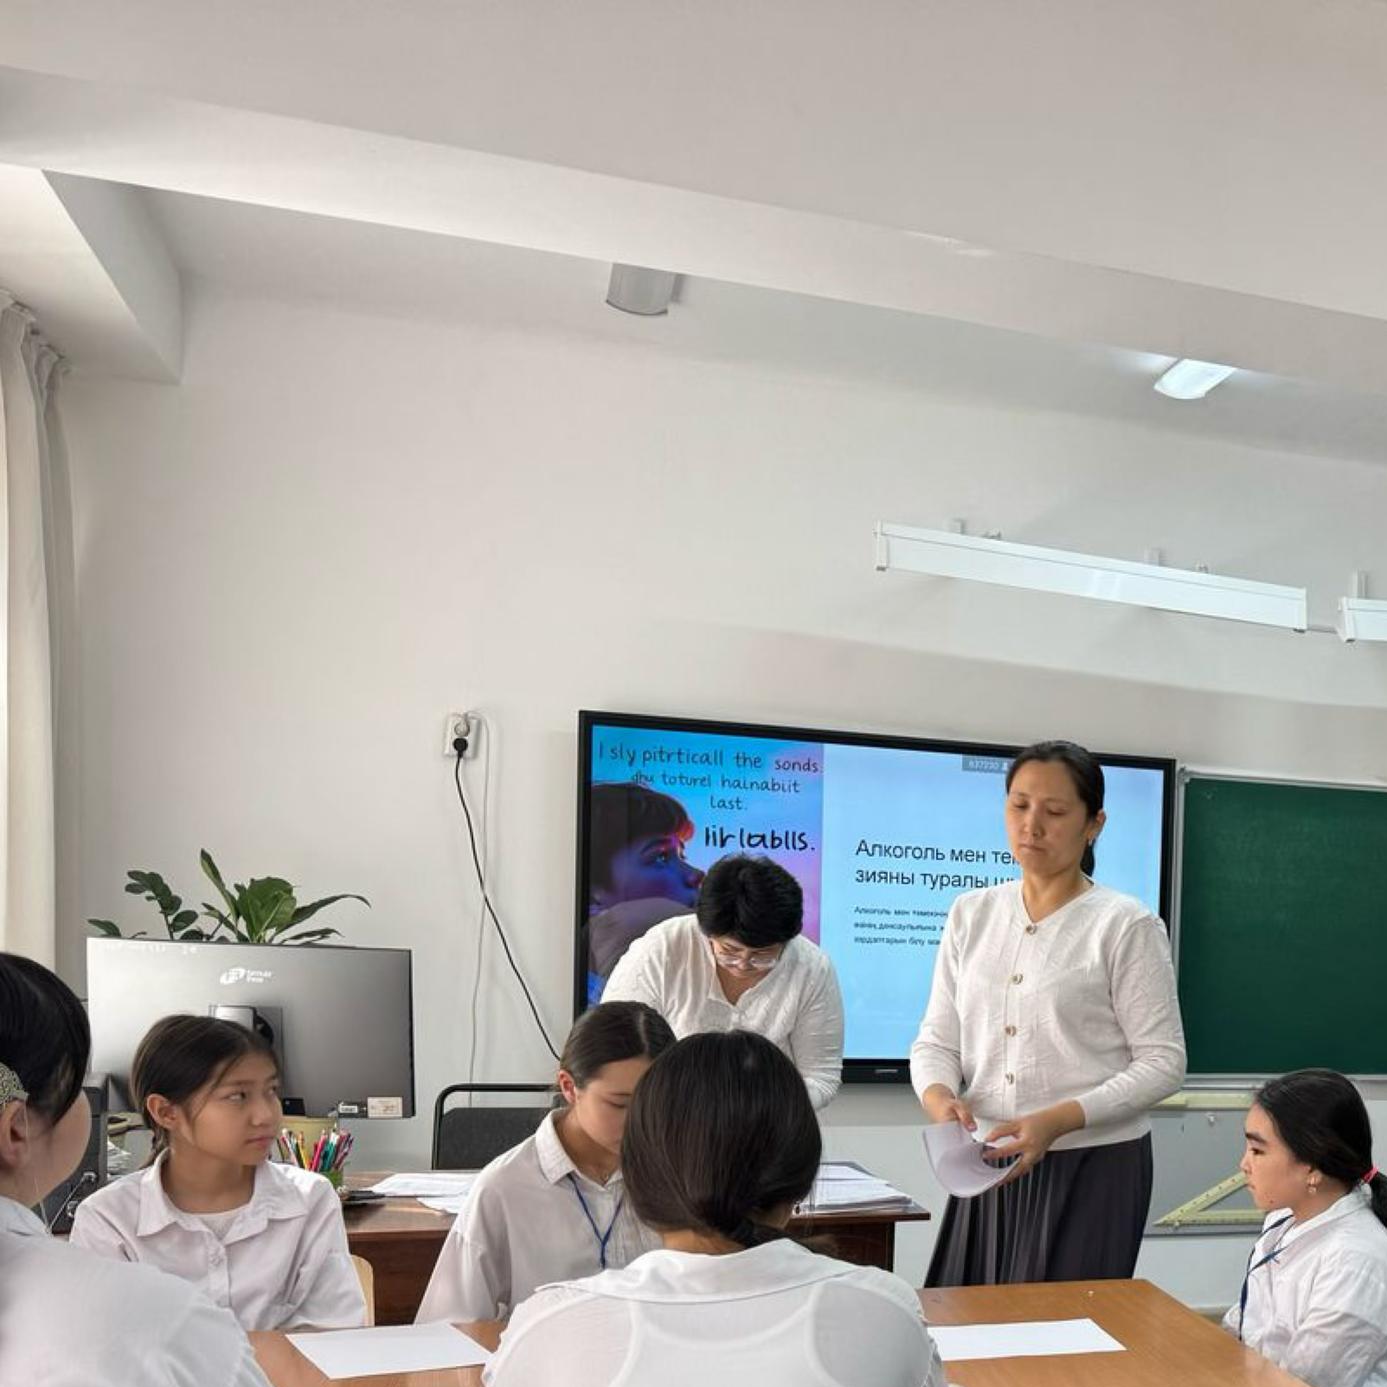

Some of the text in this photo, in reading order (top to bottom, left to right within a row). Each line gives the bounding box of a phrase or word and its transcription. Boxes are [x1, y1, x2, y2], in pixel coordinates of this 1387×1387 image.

[736, 752, 762, 769] the
[855, 839, 946, 861] Алкоголь
[950, 848, 986, 863] мен
[855, 869, 915, 885] зияны
[920, 873, 989, 890] туралы
